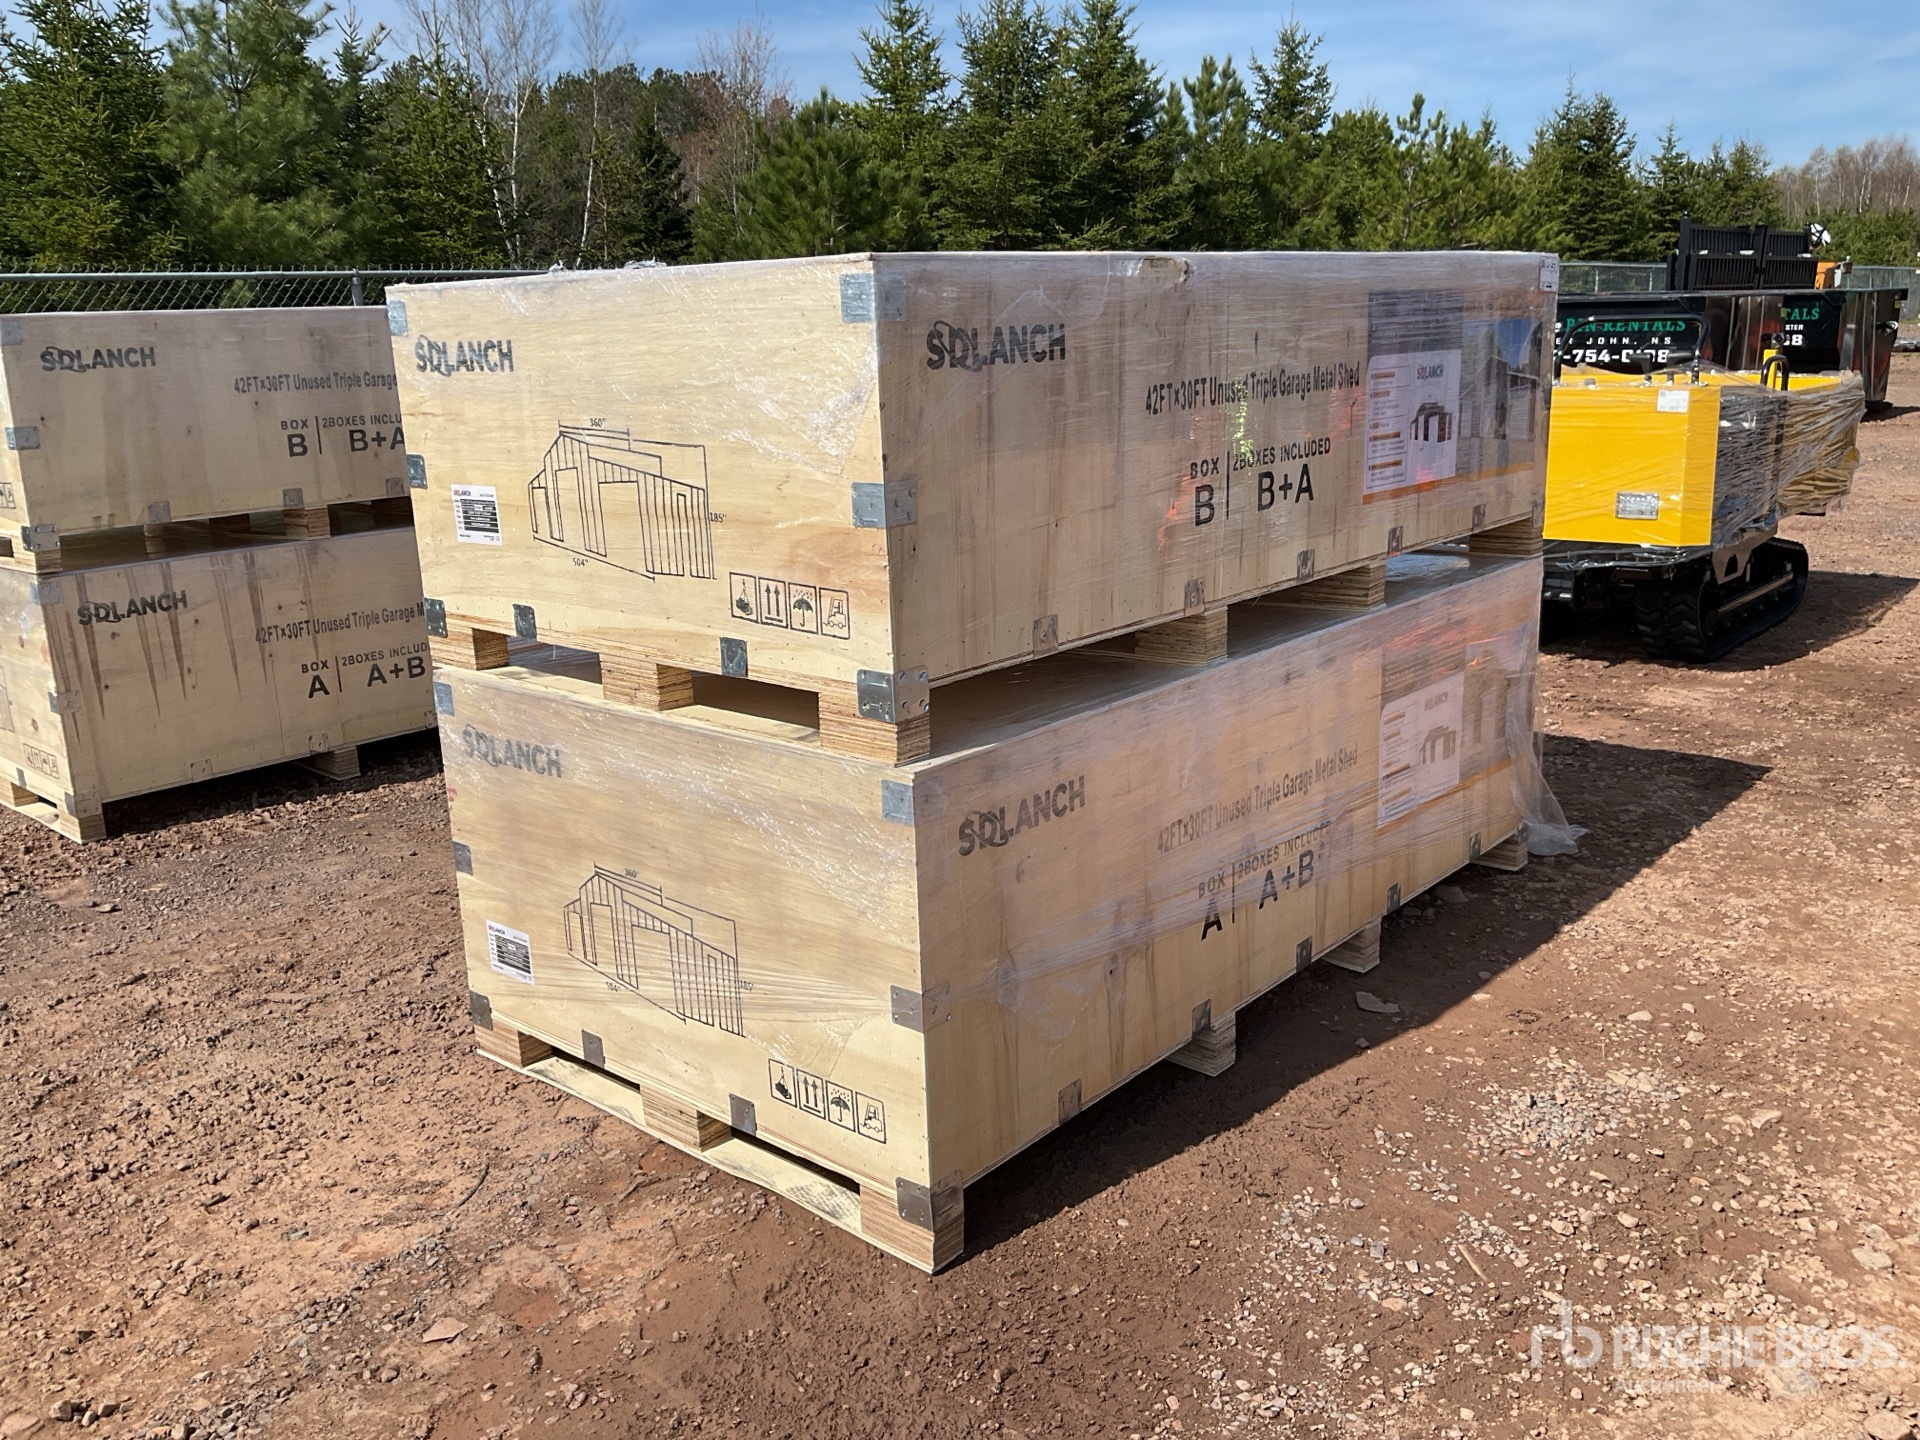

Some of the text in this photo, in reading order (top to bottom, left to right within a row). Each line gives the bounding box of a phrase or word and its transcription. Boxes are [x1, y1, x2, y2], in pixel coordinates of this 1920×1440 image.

[1565, 318, 1596, 332] BN
[1602, 319, 1687, 332] RENTALS
[1651, 337, 1671, 345] NS
[293, 372, 331, 390] Unused
[333, 372, 361, 392] Triple
[363, 371, 397, 390] Garage
[1210, 374, 1248, 406] Unused
[1250, 371, 1277, 405] Triple
[1279, 368, 1311, 400] Garage
[1313, 363, 1336, 392] Metal
[1338, 361, 1360, 389] Shed
[281, 419, 309, 430] BOX
[322, 416, 366, 428] 2BOXES
[287, 427, 405, 457] B B+A
[1190, 437, 1331, 479] BOX 2BOXES INCLUDED
[1195, 484, 1215, 526] B
[1258, 463, 1314, 512] B+A
[313, 614, 350, 634] Unused
[352, 611, 380, 629] Triple
[382, 606, 415, 623] Garage
[301, 642, 430, 673] BOX 2BOXES INCLUD
[308, 656, 426, 698] A A+B
[1215, 789, 1252, 829] Unused
[1254, 779, 1280, 812] Triple
[1282, 769, 1313, 798] Garage
[1314, 755, 1336, 783] Metal
[1338, 742, 1358, 772] Shed
[1198, 871, 1226, 898] BOX
[1238, 846, 1279, 879] 2BOXES
[1201, 849, 1314, 941] A A+B
